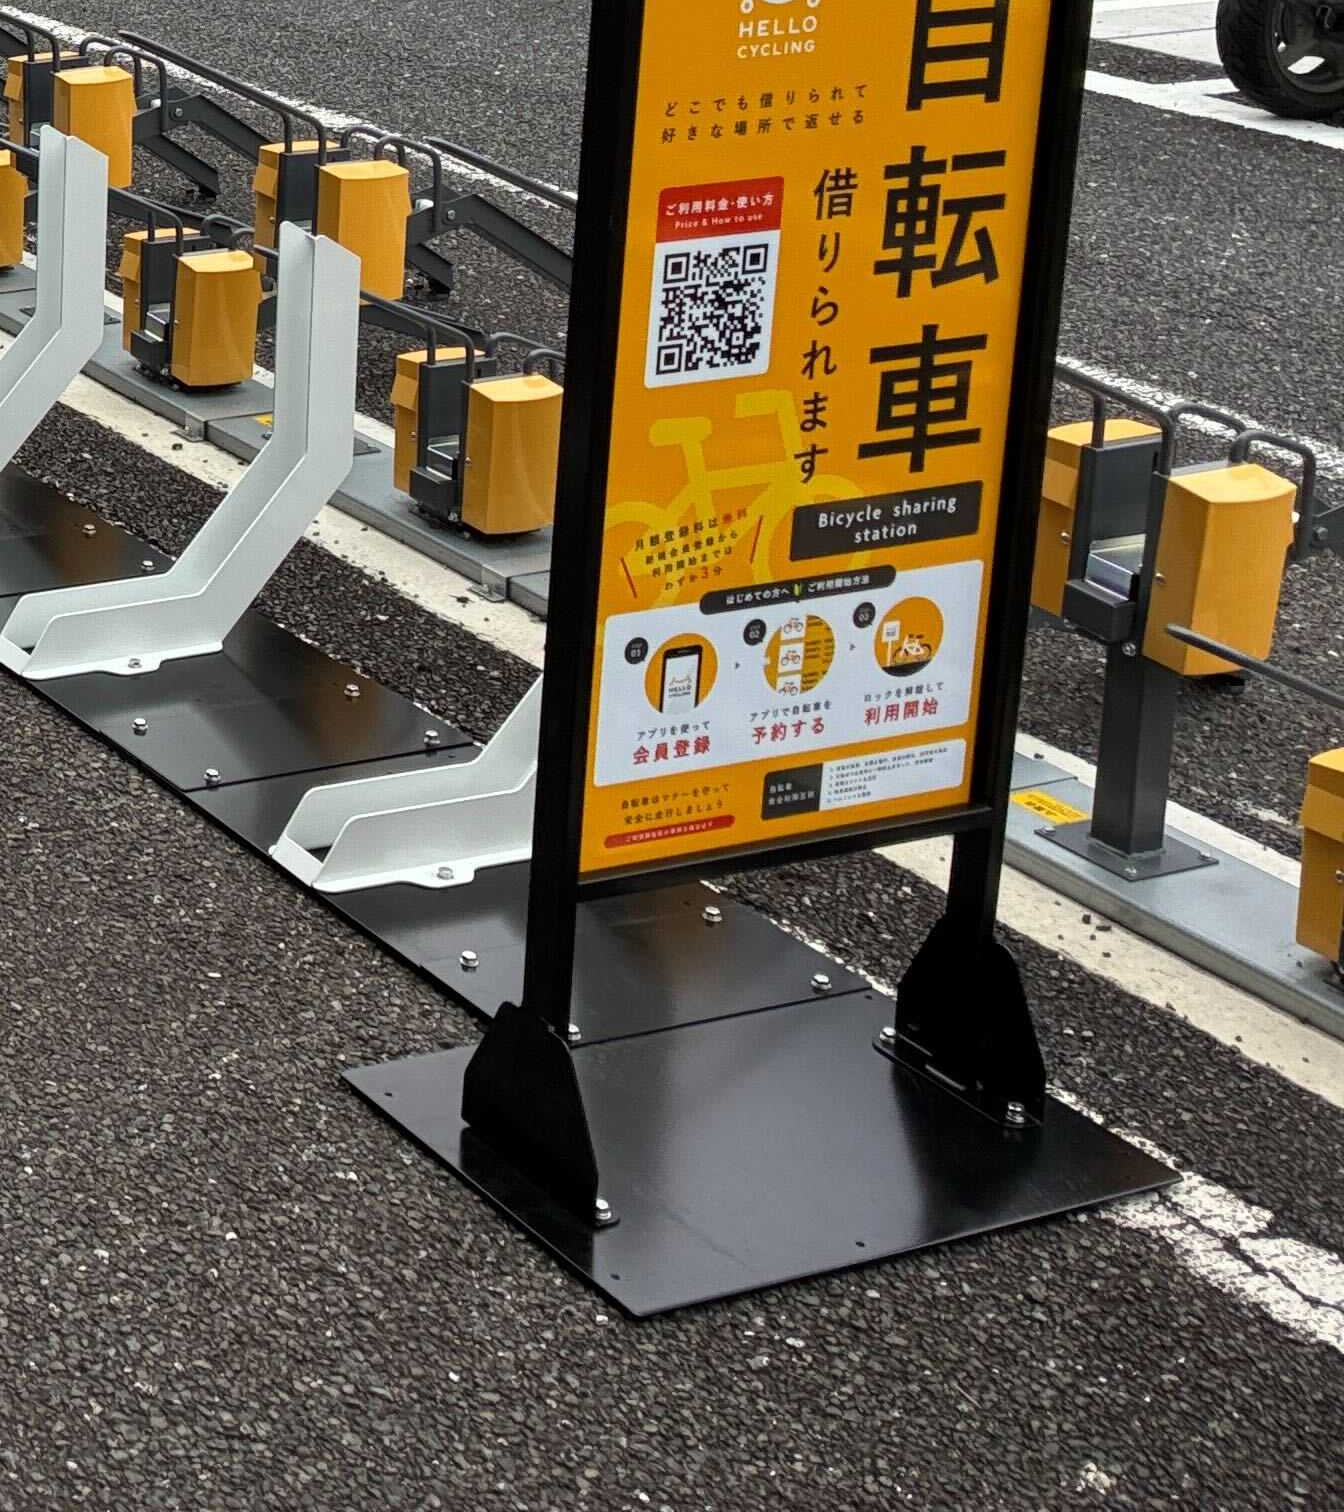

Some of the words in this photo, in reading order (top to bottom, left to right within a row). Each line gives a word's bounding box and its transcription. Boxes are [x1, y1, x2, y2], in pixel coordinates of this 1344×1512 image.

[738, 15, 818, 39] HELLO
[736, 39, 816, 59] CYCLING
[664, 84, 868, 118] どこでも借りられて
[661, 109, 864, 144] 好きな場所で返せる
[674, 218, 699, 230] Price
[701, 217, 709, 227] &
[711, 215, 732, 227] How
[734, 214, 745, 224] to
[794, 166, 859, 485] 借りられます
[818, 504, 882, 529] Bicycle
[893, 497, 958, 517] sharing
[853, 523, 918, 544] station
[725, 587, 790, 605] はじめての方へ
[749, 699, 833, 722] アプリで自転車を
[864, 697, 939, 726] 利用開始
[637, 720, 711, 741] アプリを使って
[751, 716, 826, 745] 予約する
[632, 735, 711, 765] 会員登録
